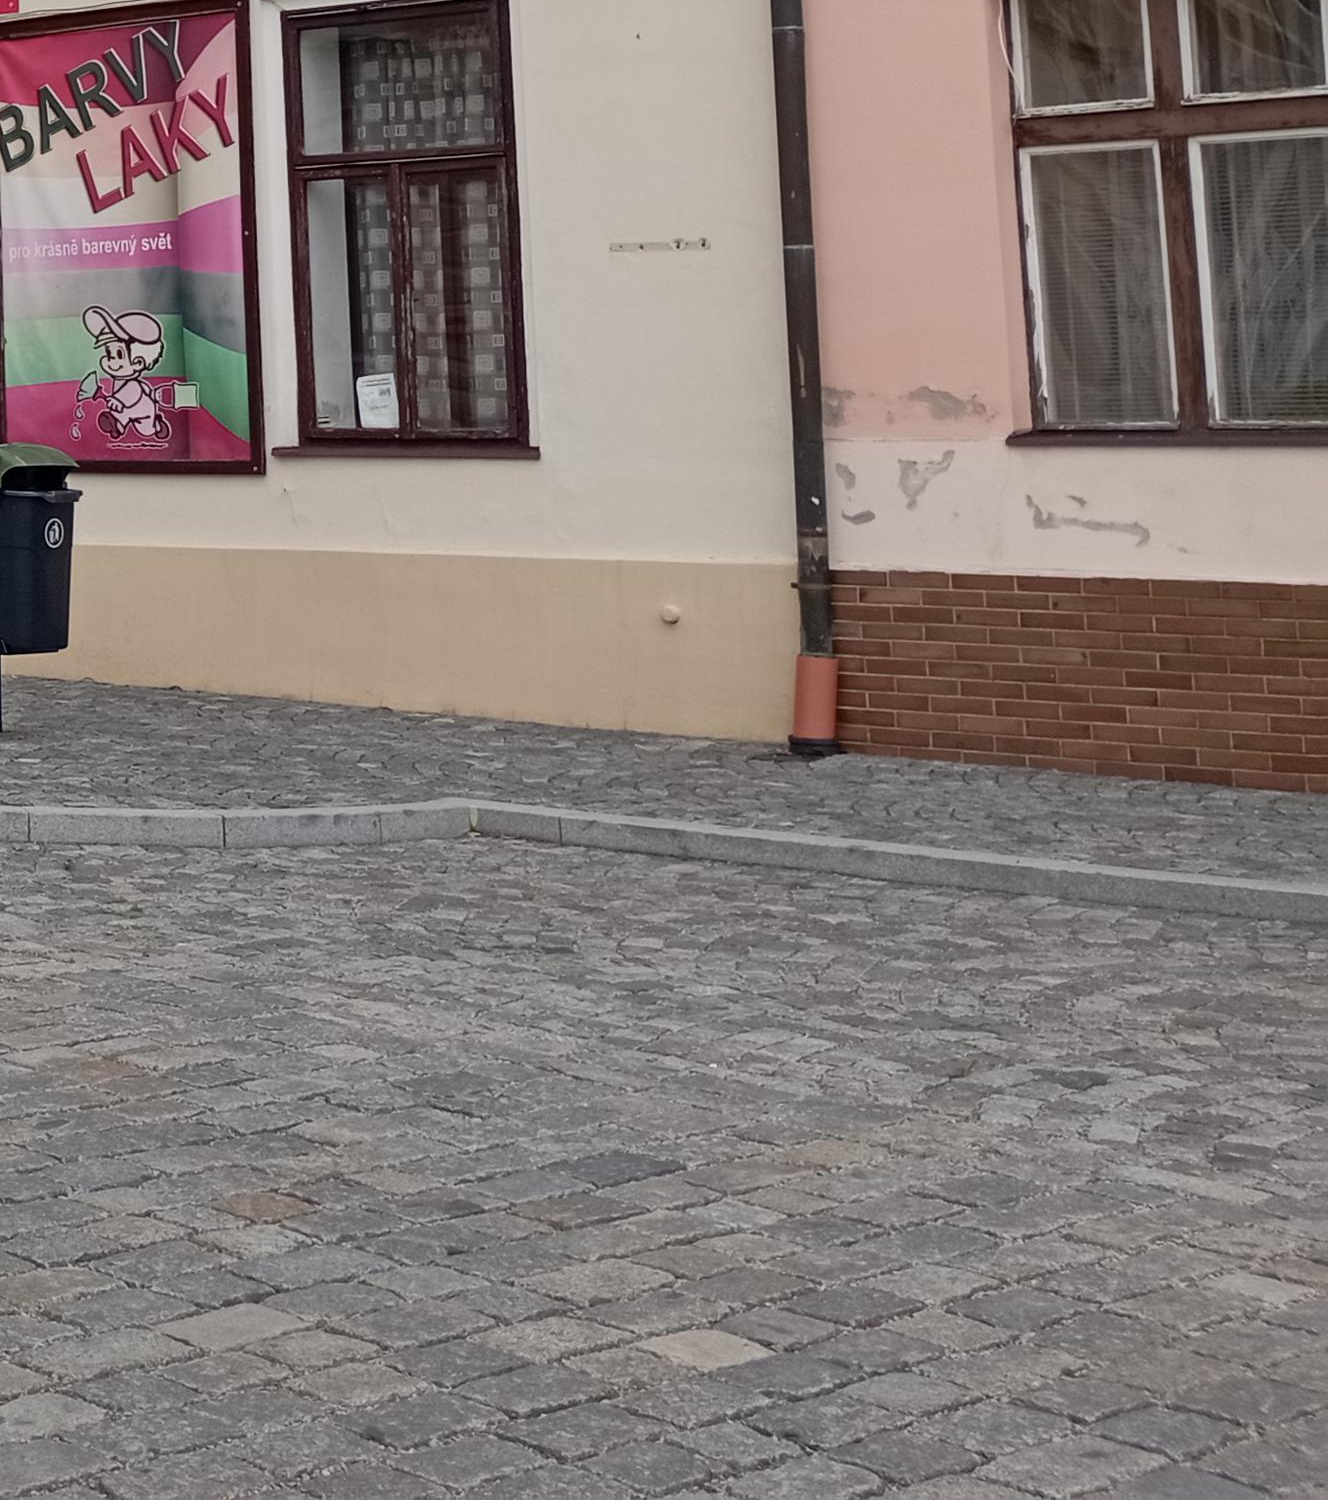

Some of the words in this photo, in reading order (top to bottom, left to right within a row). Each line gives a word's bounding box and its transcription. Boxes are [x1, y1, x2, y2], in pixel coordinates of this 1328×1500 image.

[0, 20, 185, 172] BARVY
[76, 73, 235, 214] LAKY
[9, 245, 30, 262] pro
[82, 235, 137, 256] barevný
[141, 233, 172, 251] svět
